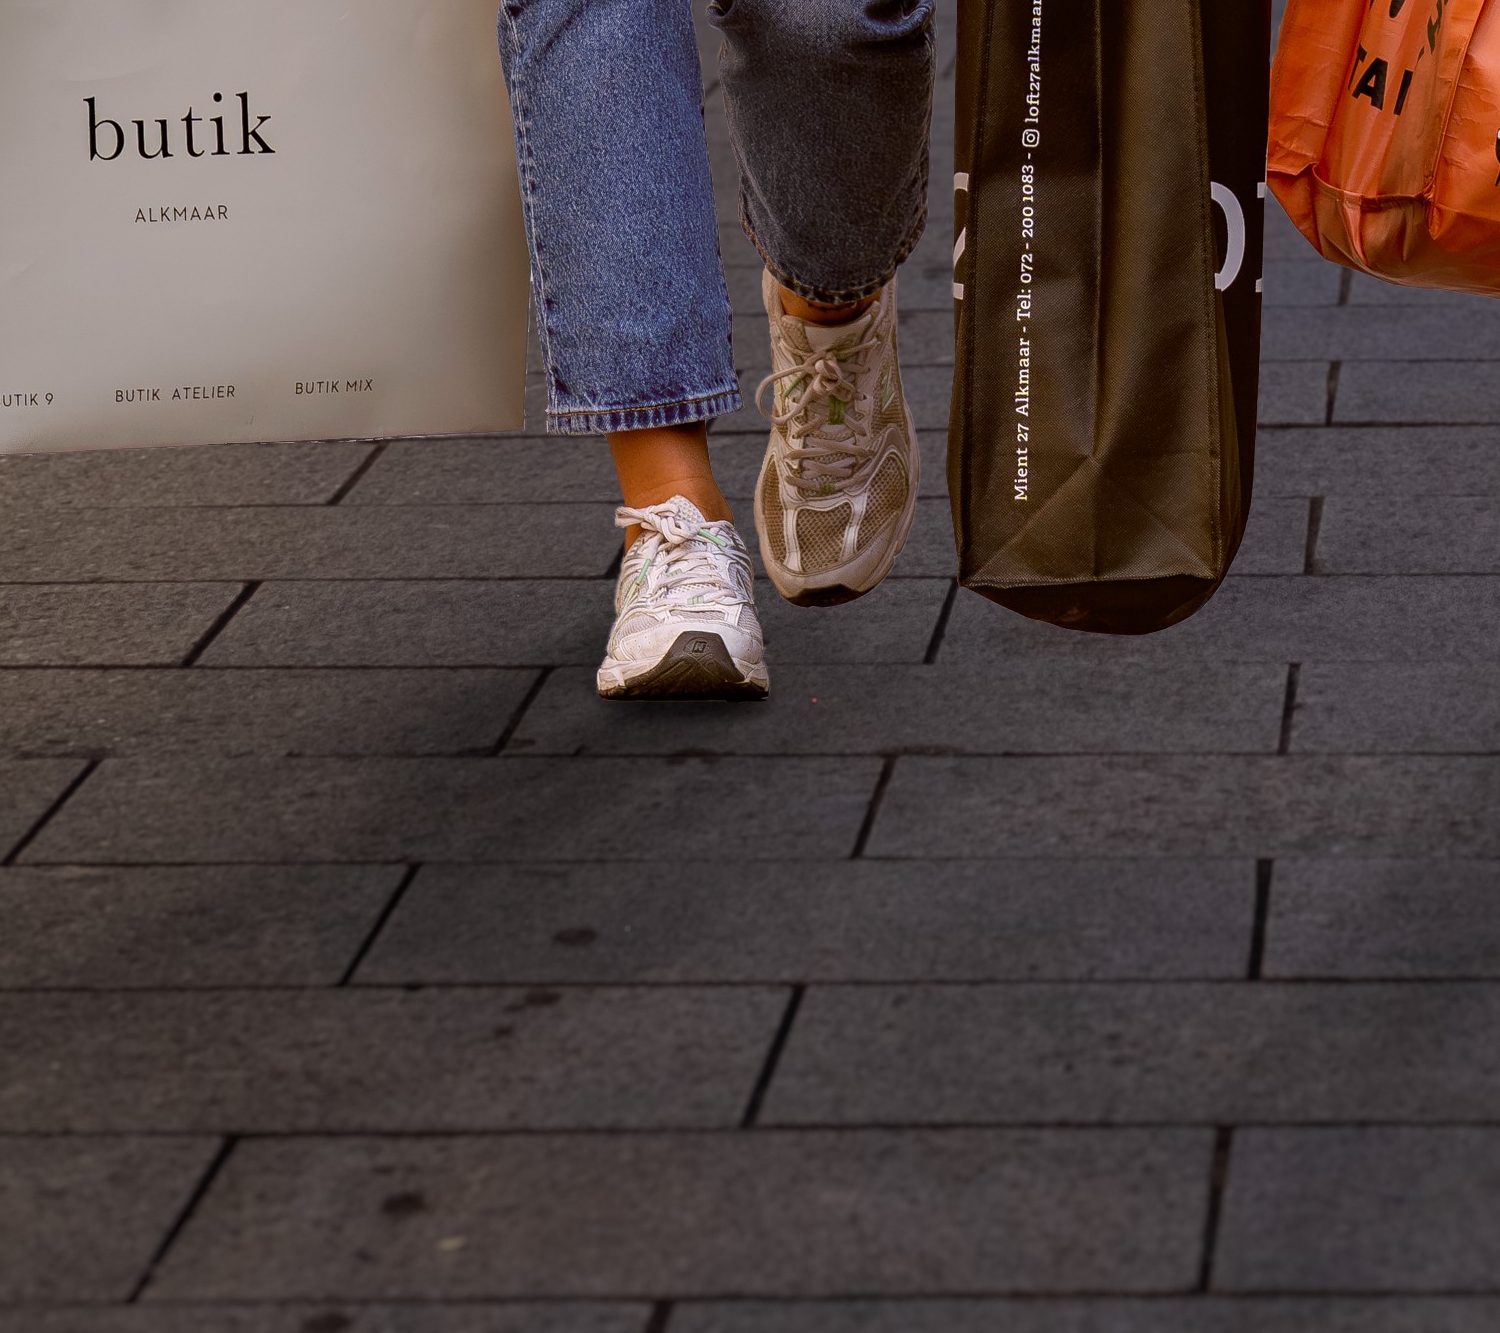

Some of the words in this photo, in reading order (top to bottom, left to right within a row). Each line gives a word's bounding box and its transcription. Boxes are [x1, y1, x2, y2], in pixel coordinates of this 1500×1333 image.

[82, 91, 276, 161] butik
[1021, 164, 1034, 203] 1083
[134, 204, 228, 223] ALKMAAR
[1021, 206, 1034, 238] 200
[1020, 253, 1034, 284] 072
[1016, 288, 1032, 322] Tel:
[295, 380, 340, 395] BUTIK
[345, 376, 374, 394] MIX
[1014, 337, 1030, 417] Alkmaar
[45, 392, 54, 406] 9
[115, 388, 161, 403] BUTIK
[171, 384, 236, 401] ATELIER
[1016, 422, 1030, 443] 27
[1013, 447, 1029, 502] Mient
